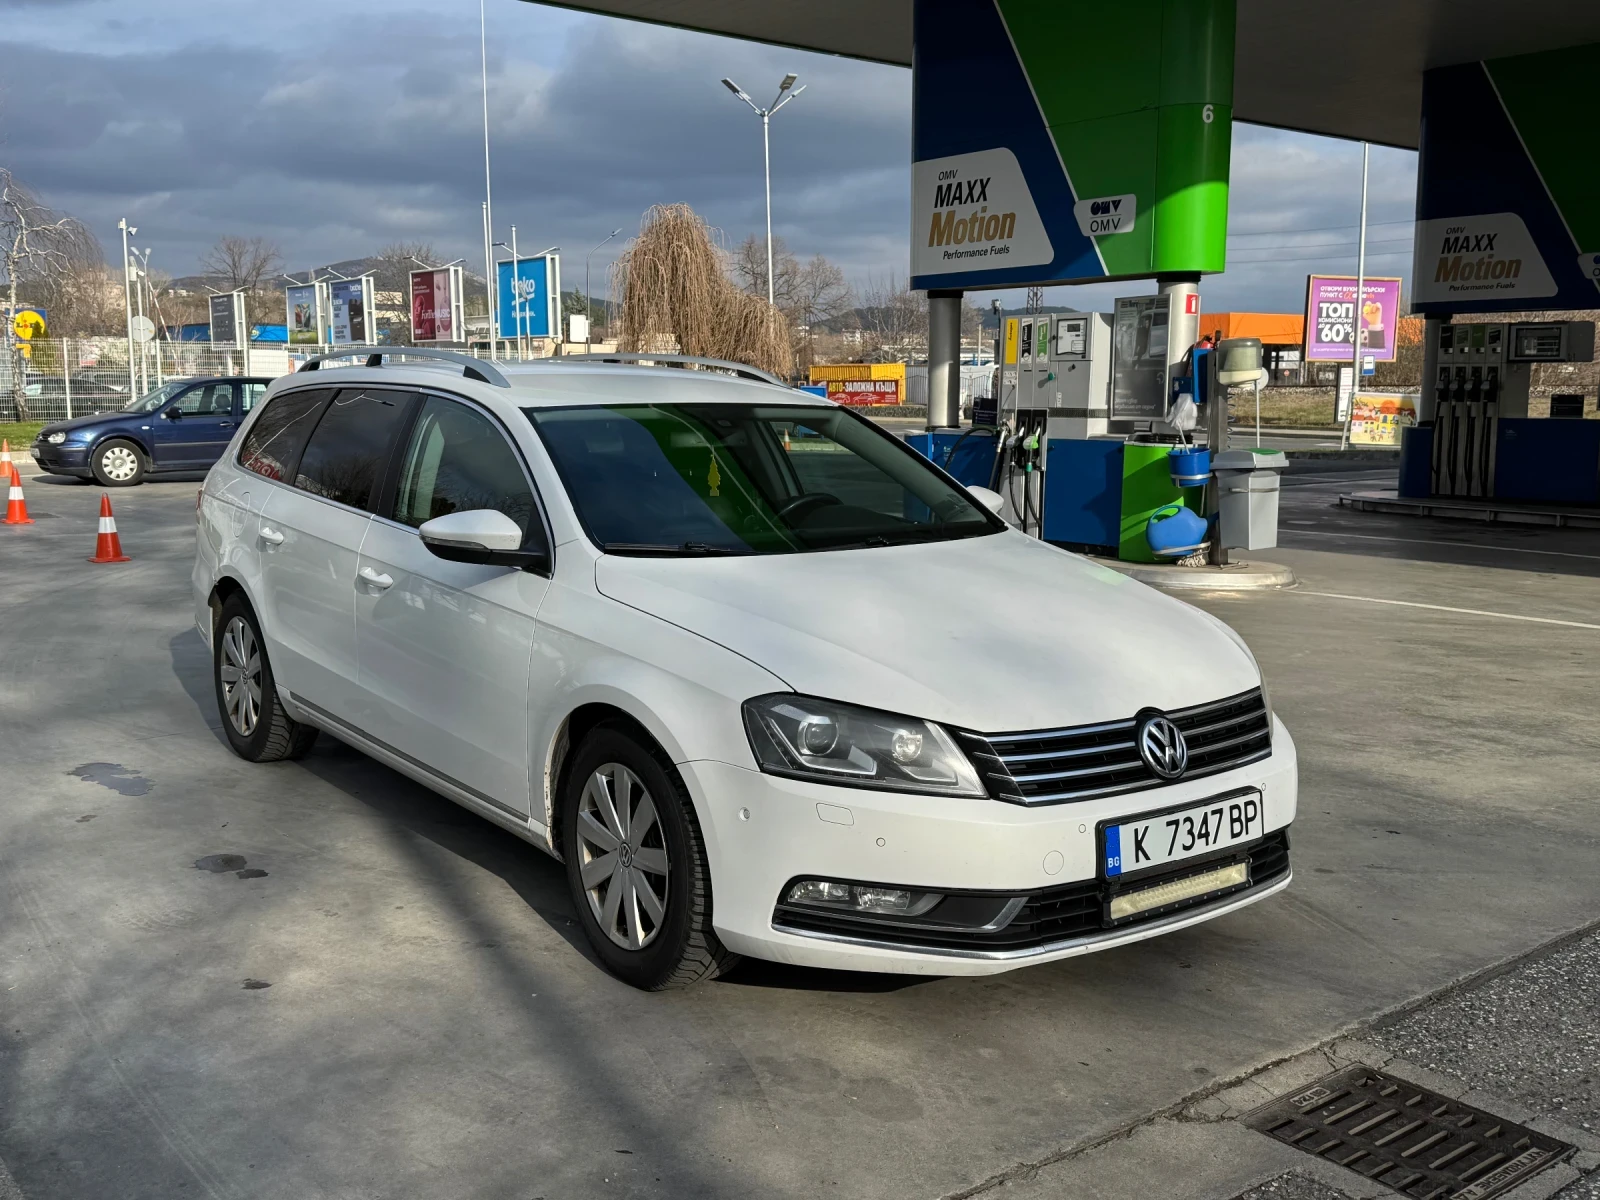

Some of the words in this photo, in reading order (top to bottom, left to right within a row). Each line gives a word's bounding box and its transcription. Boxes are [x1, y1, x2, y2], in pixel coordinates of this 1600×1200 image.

[1202, 104, 1214, 123] 6
[938, 169, 959, 181] OMV
[934, 177, 991, 208] MAXX
[928, 206, 1016, 247] Motion
[1090, 218, 1121, 232] OMV
[1446, 227, 1465, 235] OMV
[1441, 234, 1498, 254] MAXX
[943, 248, 988, 260] Performance
[989, 245, 1010, 256] Fuels
[1434, 254, 1522, 282] Motion
[1449, 284, 1494, 292] Performance
[1319, 303, 1354, 317] ТОП
[1321, 324, 1352, 342] 60%
[829, 381, 874, 392] АВТО-ЗАЛОЖНА
[875, 382, 896, 393] КЪЩА
[1133, 825, 1151, 863] K
[1166, 807, 1223, 856] 7347
[1229, 799, 1258, 839] BP
[1108, 856, 1120, 868] BG
